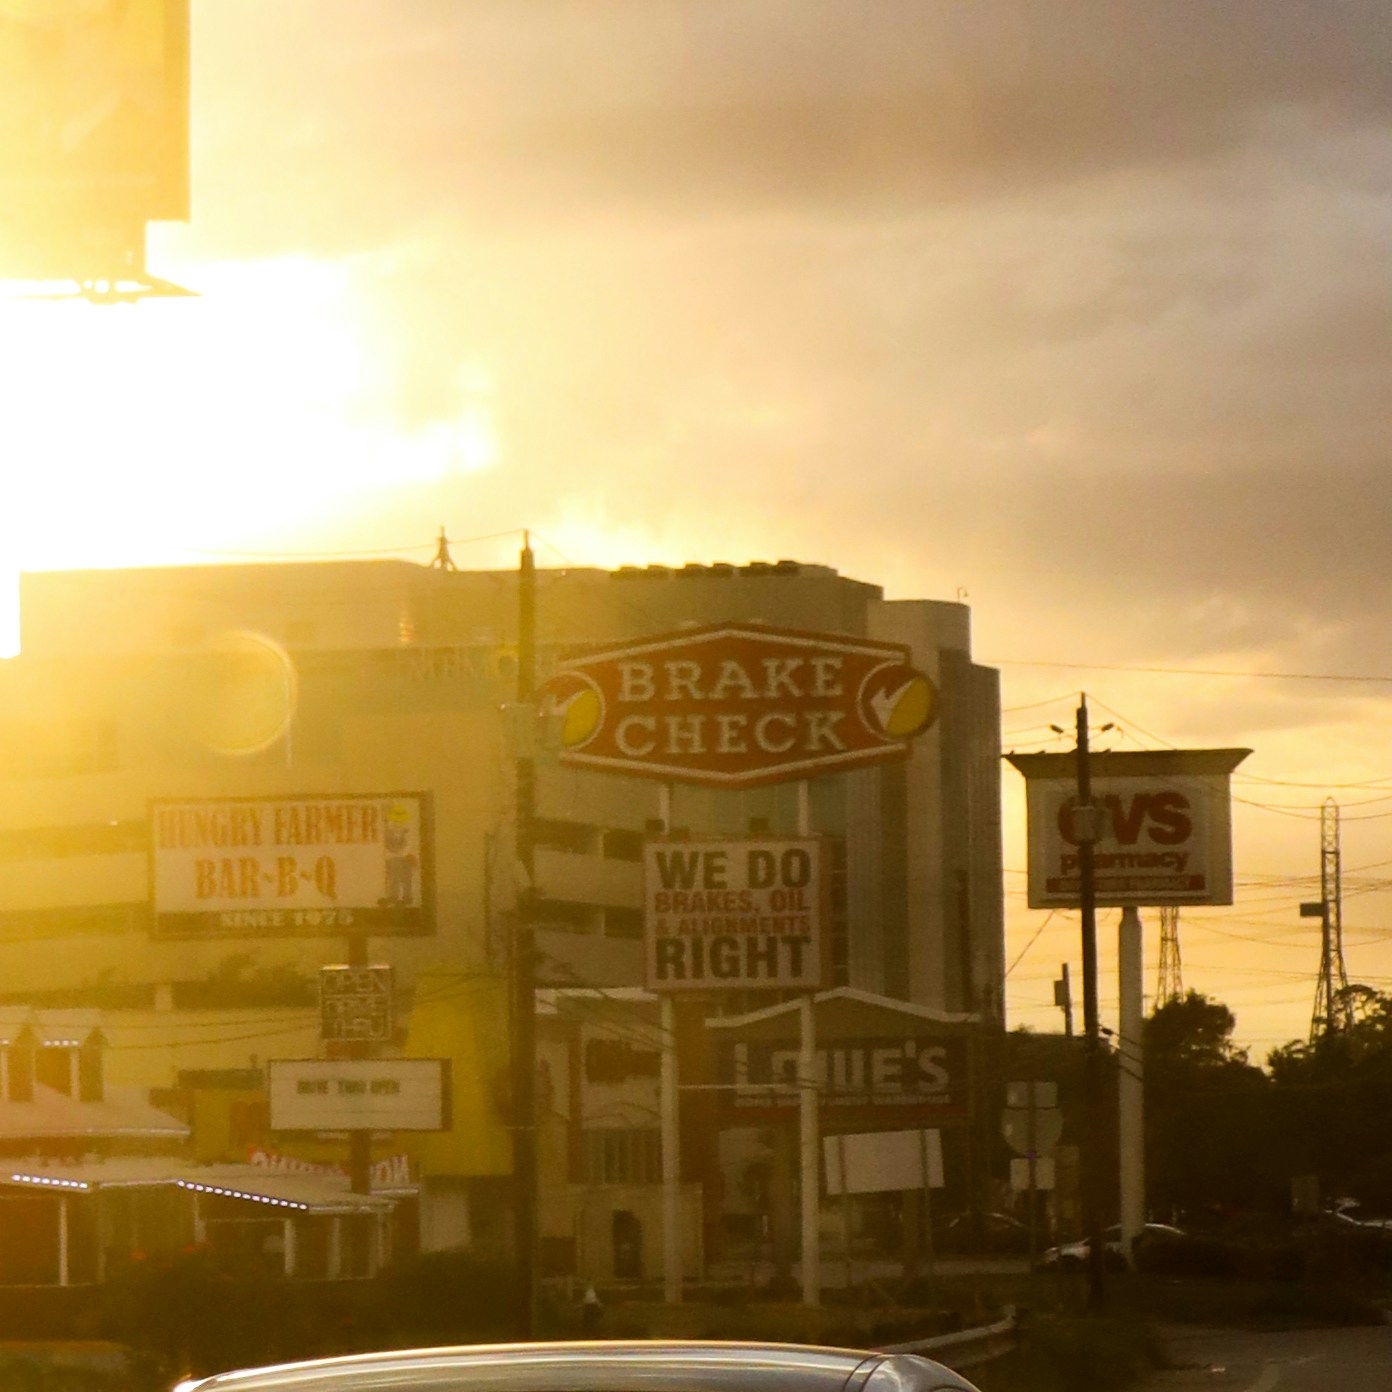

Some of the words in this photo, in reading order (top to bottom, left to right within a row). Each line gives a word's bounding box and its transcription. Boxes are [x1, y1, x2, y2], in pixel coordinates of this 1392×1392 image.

[617, 656, 845, 702] BRAKE
[614, 710, 847, 757] CHECK
[158, 805, 261, 849] HUNGRY
[274, 802, 379, 846] FARMER
[1059, 789, 1192, 845] CVS
[655, 850, 728, 890] WE
[746, 848, 812, 890] DO
[1060, 851, 1189, 876] parmacy
[220, 910, 286, 928] SINCE
[769, 888, 812, 912] OIL
[677, 915, 812, 936] ALIGNMENTS
[655, 935, 812, 981] RIGHT
[734, 1039, 950, 1095] LOWE'S
